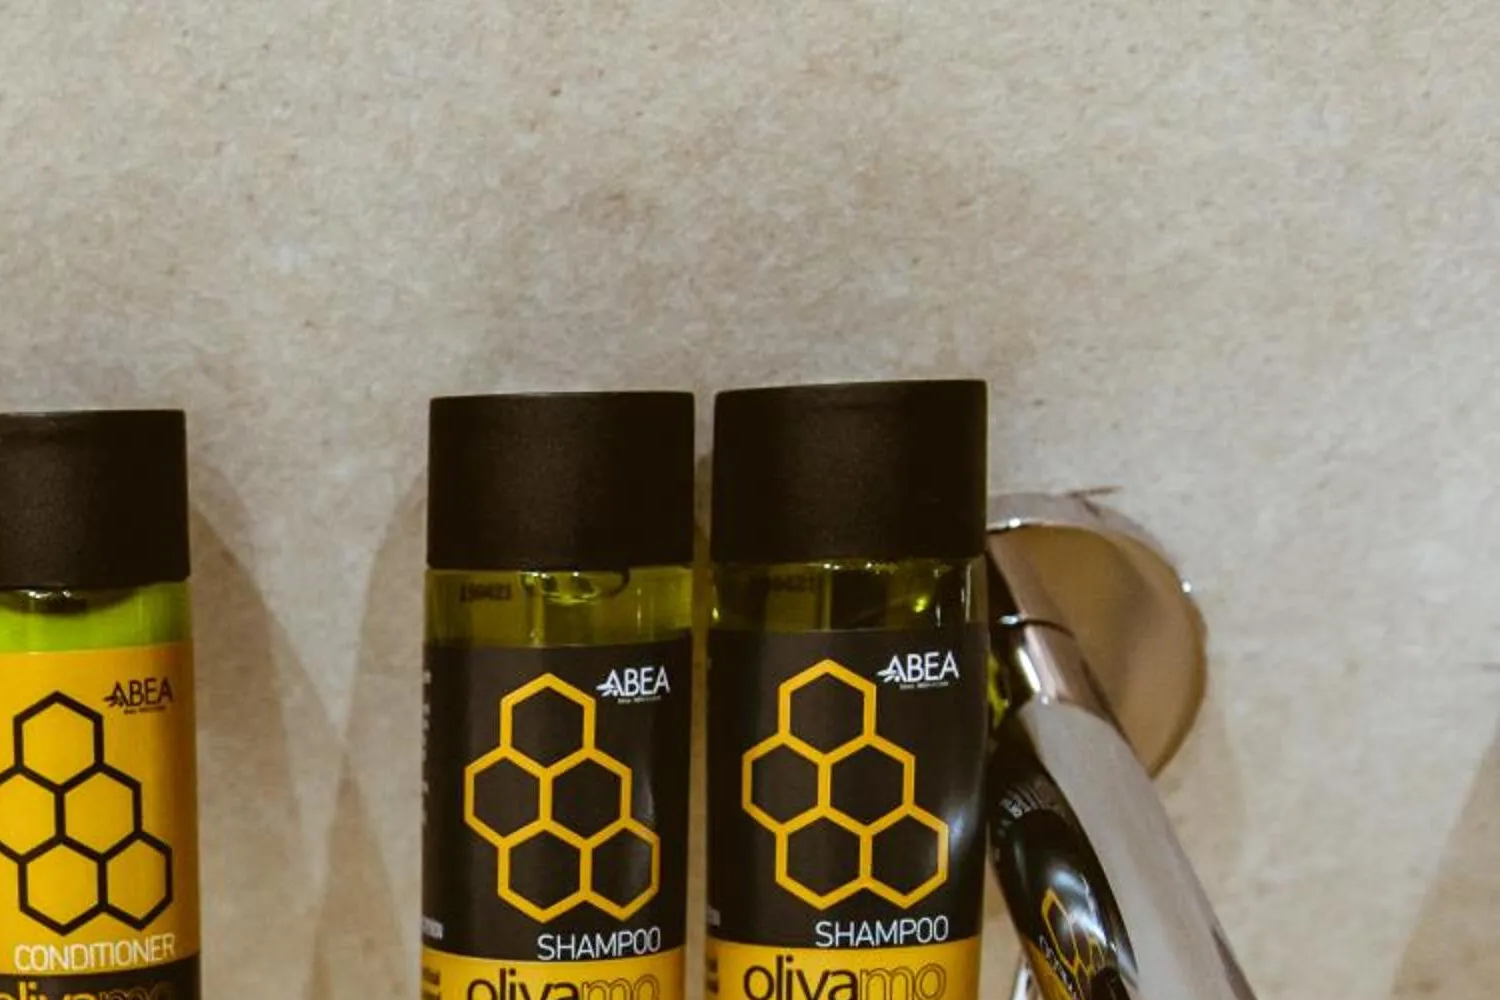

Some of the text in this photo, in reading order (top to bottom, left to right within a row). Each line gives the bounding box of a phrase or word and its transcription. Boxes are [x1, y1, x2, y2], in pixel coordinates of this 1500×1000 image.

[597, 665, 671, 697] ABEA
[878, 650, 960, 683] ABEA
[103, 676, 174, 707] ABEA
[537, 926, 661, 960] SHAMPOO
[815, 915, 949, 947] SHAMPOO
[14, 933, 176, 972] CONDITIONER
